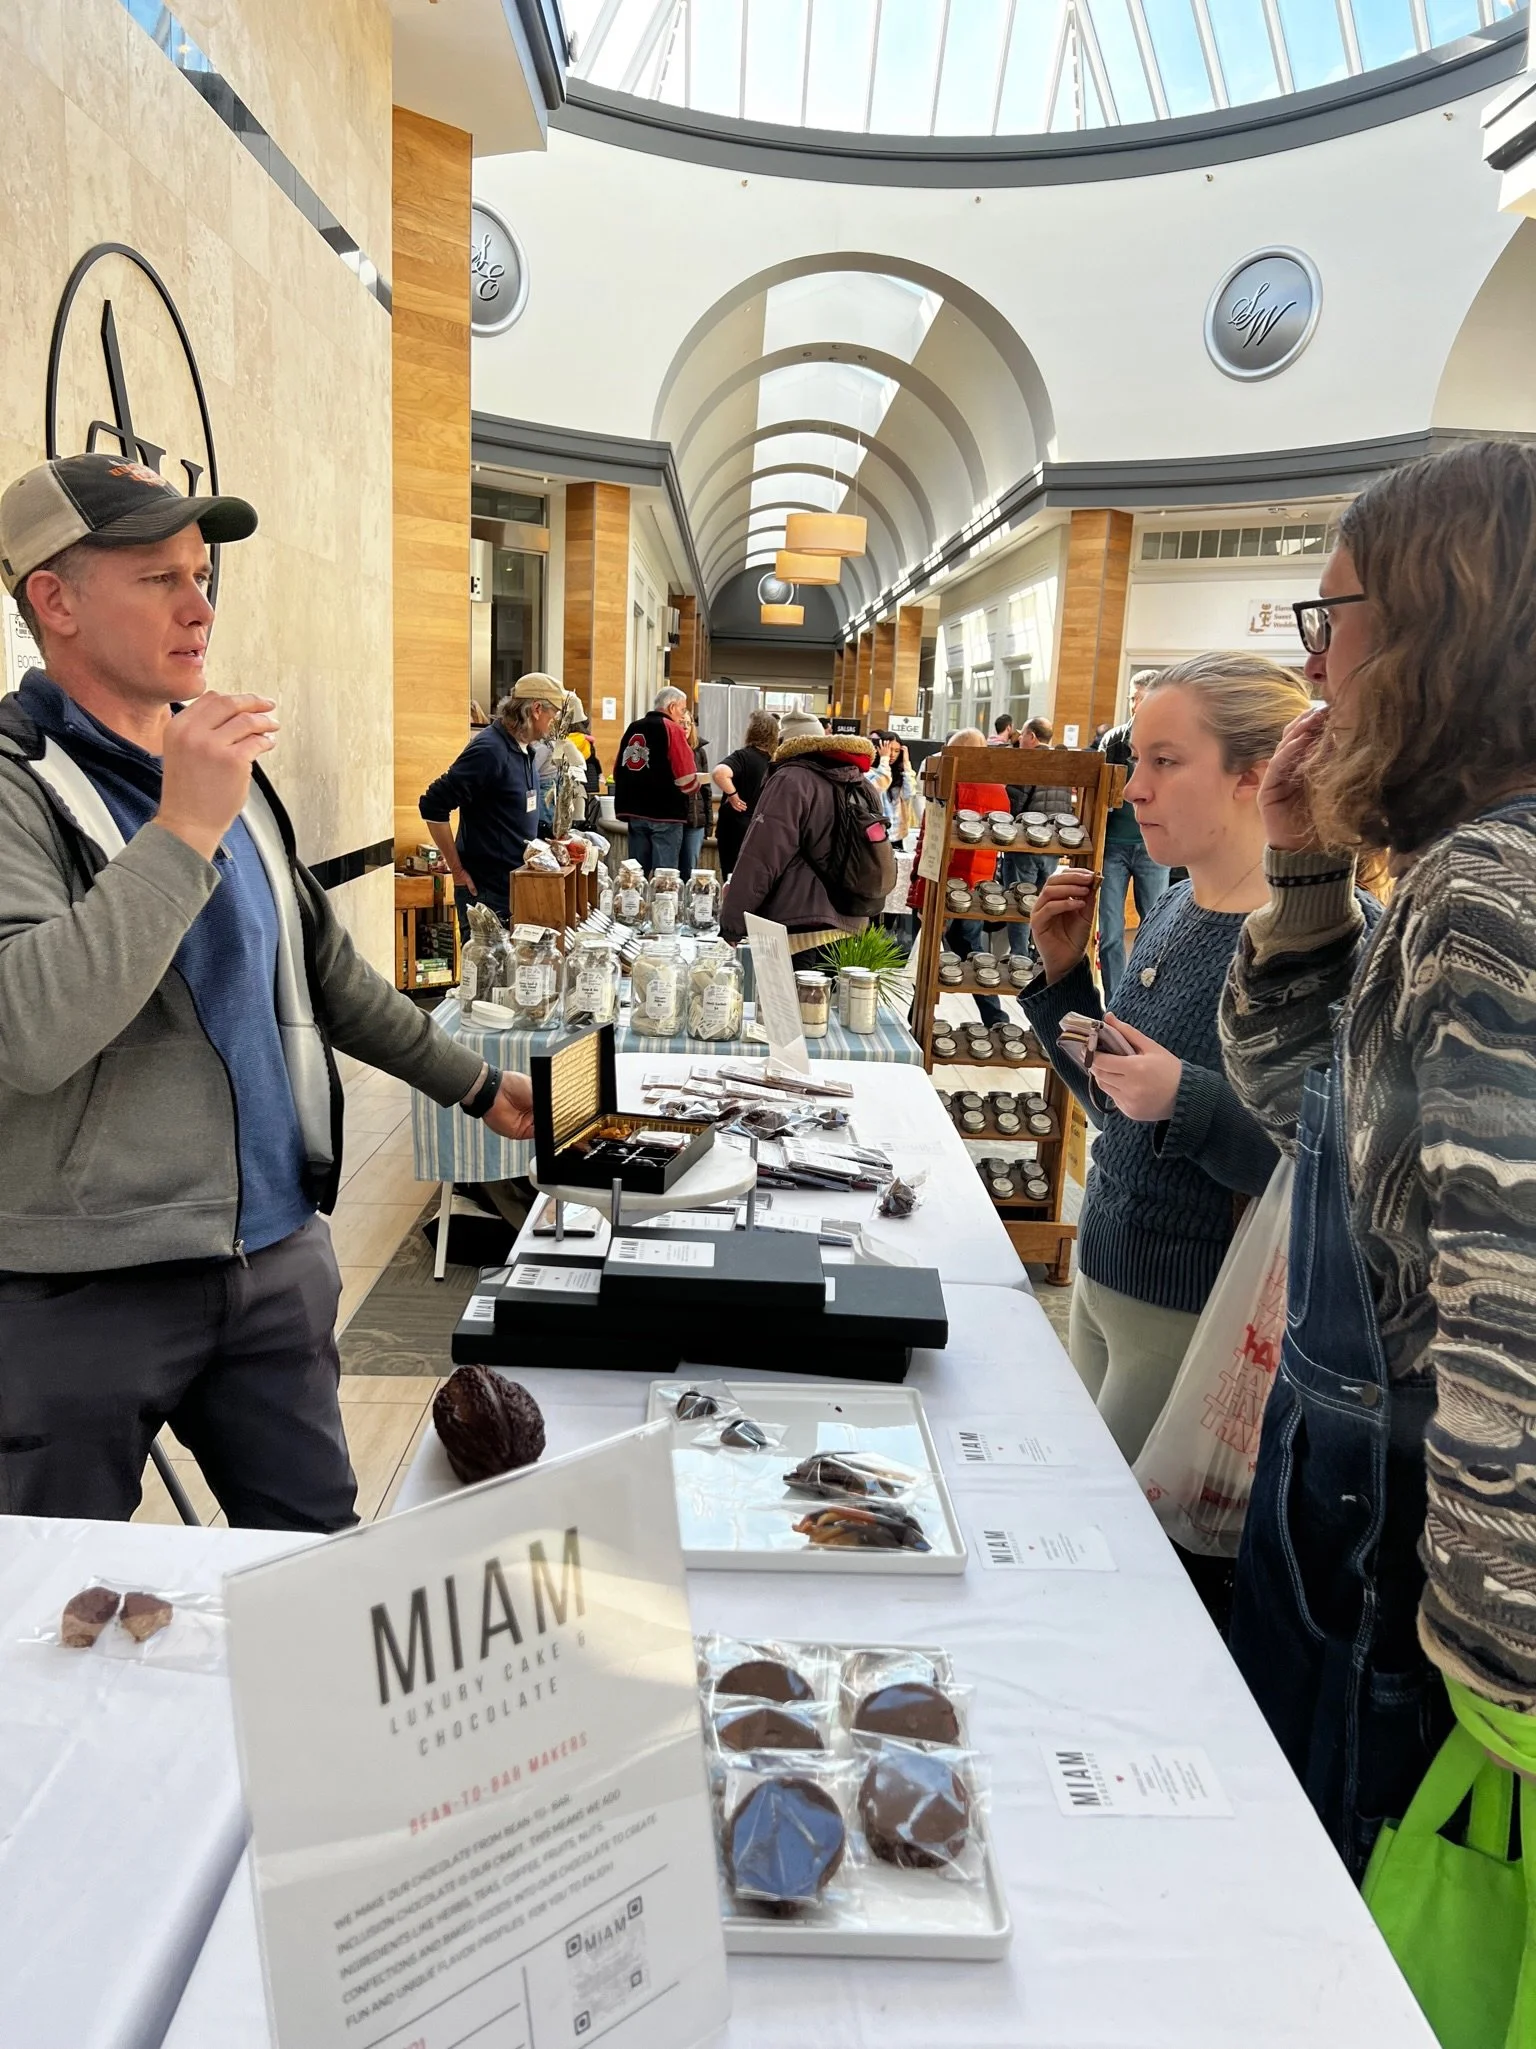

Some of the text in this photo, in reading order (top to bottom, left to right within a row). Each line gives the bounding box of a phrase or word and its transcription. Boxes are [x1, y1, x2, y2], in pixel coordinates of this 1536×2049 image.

[516, 1266, 541, 1286] MIAM
[958, 1431, 986, 1461] MIAM
[983, 1530, 1015, 1564] MIAM
[370, 1526, 585, 1706] MIAM
[391, 1675, 484, 1735] LUXURY
[504, 1642, 561, 1682] CAKE
[418, 1676, 558, 1757] CHOCOLATE
[1055, 1751, 1101, 1806] MIAM
[584, 1916, 627, 1953] MIAM
